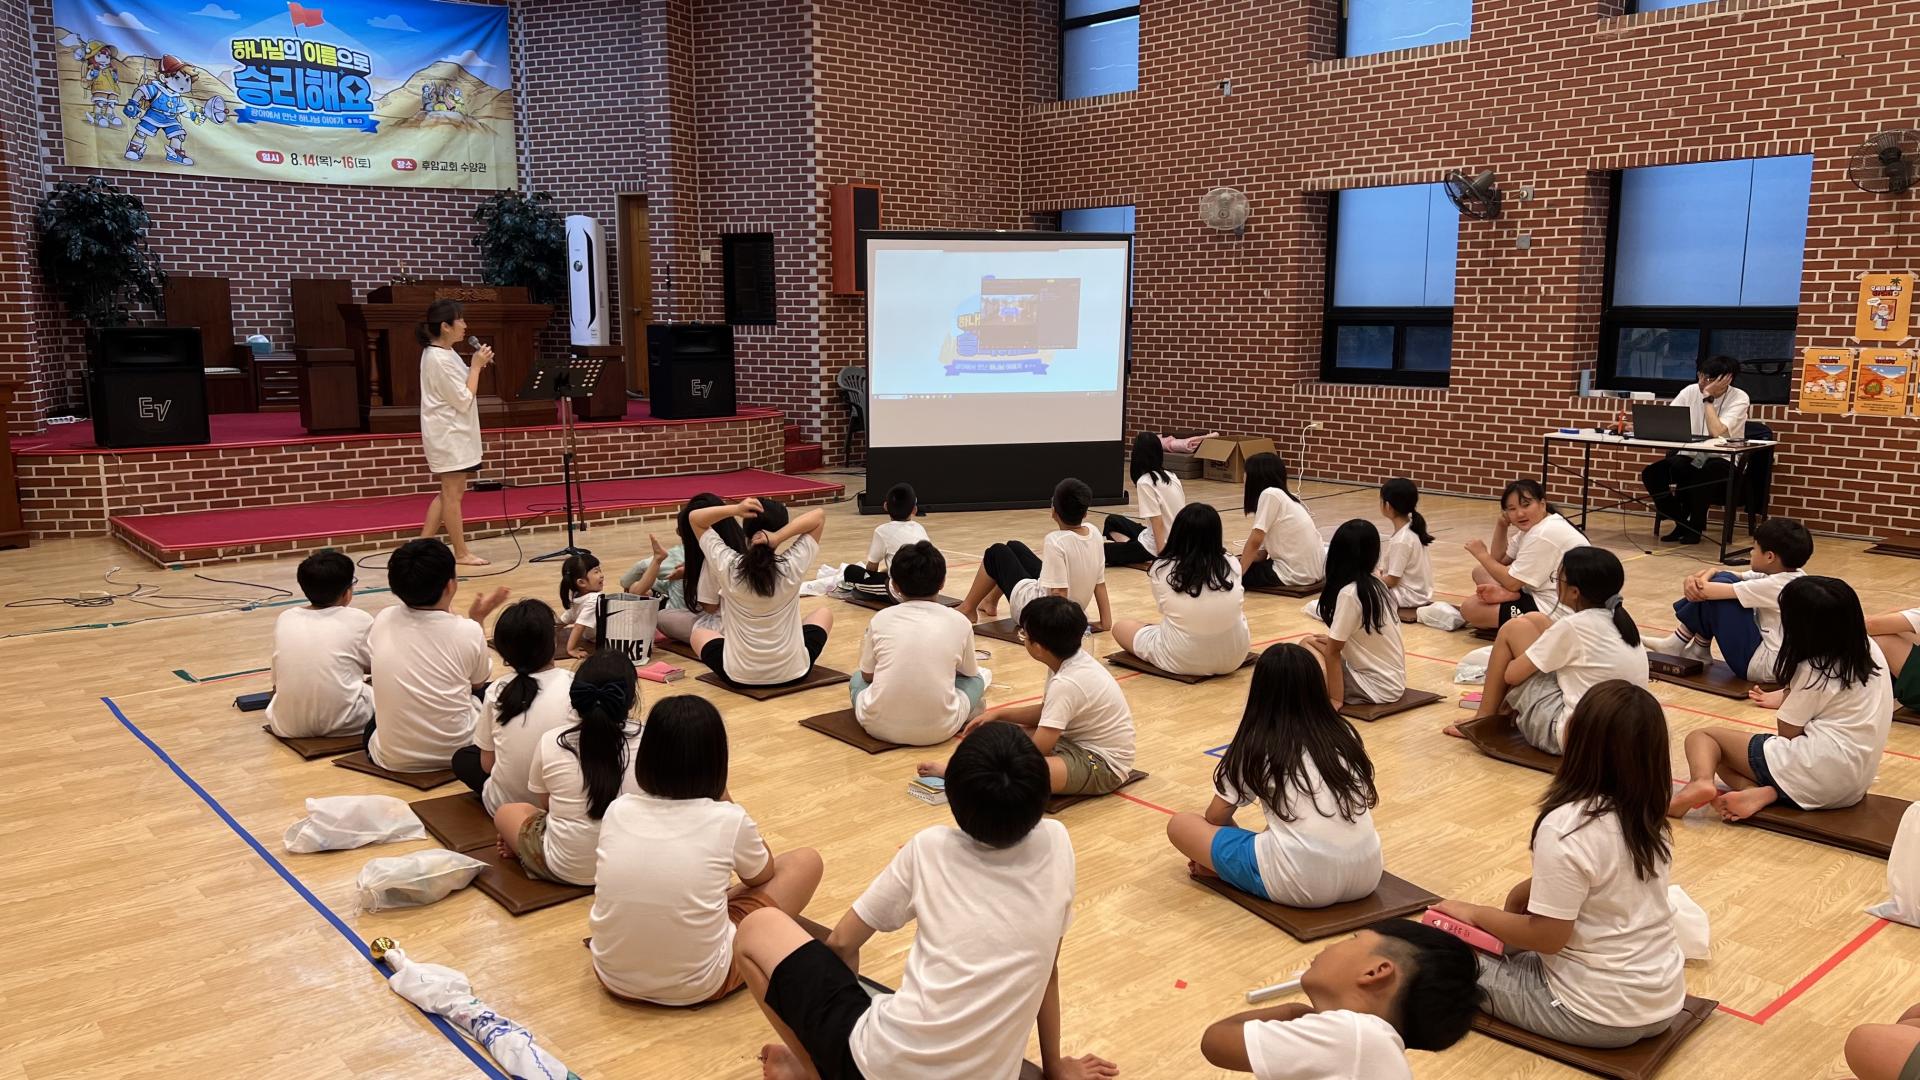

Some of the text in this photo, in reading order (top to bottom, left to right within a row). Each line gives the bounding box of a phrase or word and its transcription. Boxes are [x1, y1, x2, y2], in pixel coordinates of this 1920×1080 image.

[232, 39, 370, 73] 하나님의 이름으로
[235, 65, 374, 112] 승리해요
[261, 152, 281, 162] 일시
[396, 160, 487, 173] 장소 후암교회 수양관
